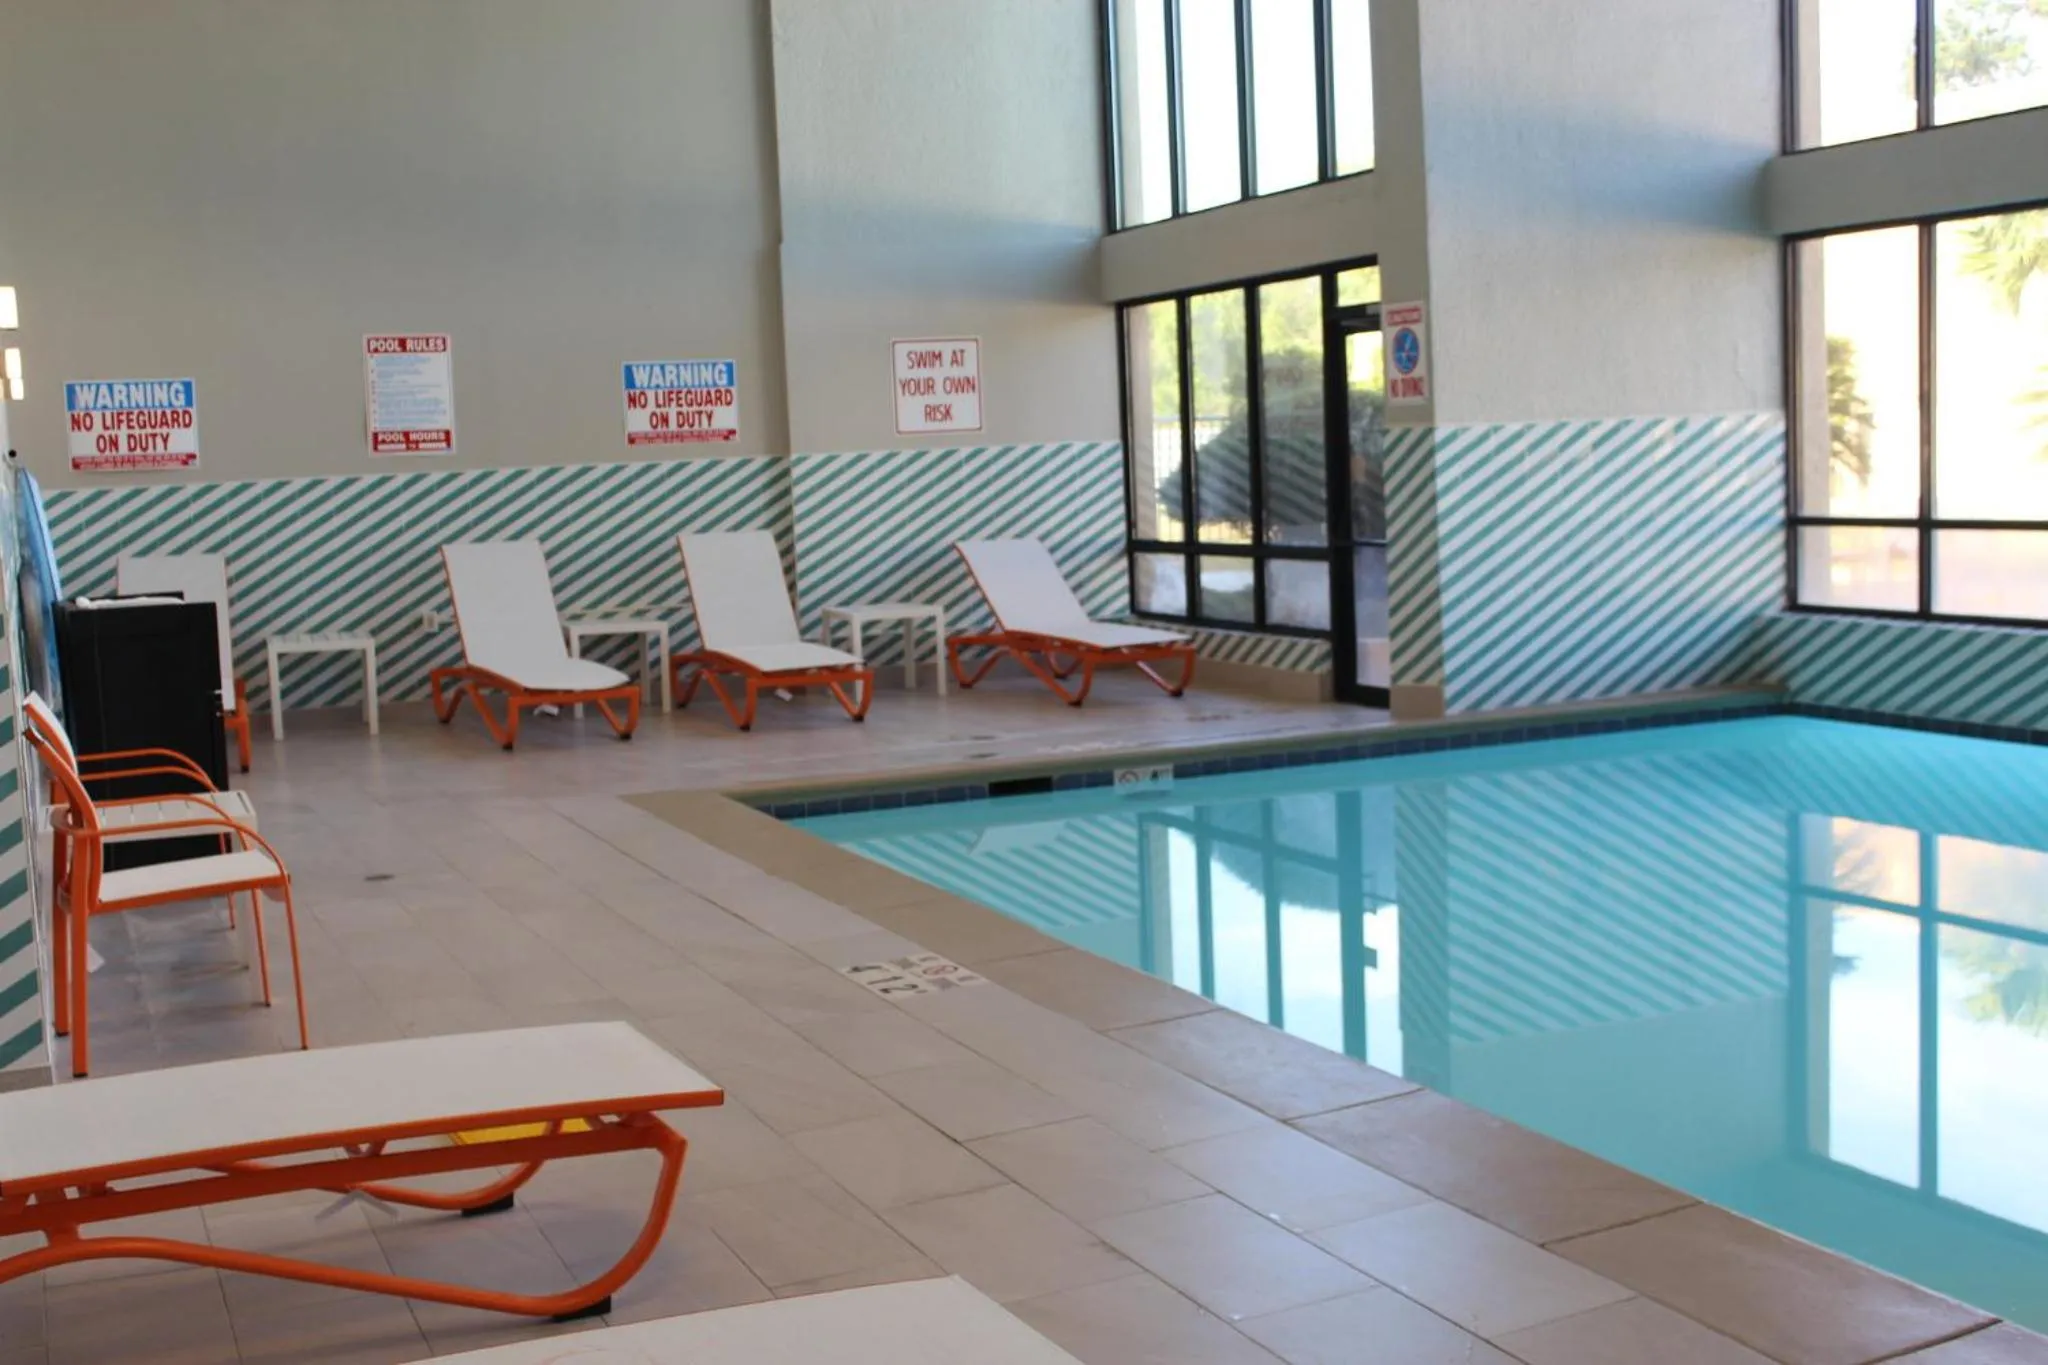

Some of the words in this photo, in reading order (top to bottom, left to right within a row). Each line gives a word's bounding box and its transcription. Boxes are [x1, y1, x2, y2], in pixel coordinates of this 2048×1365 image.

[369, 339, 402, 352] POOL
[406, 338, 445, 352] RULES
[906, 350, 943, 369] SWIM
[950, 349, 966, 368] AT
[632, 363, 728, 388] WARNING
[75, 382, 186, 410] WARNING
[899, 377, 936, 396] YOUR
[943, 376, 976, 395] OWN
[627, 391, 648, 409] NO
[655, 388, 733, 408] LIFEGUARD
[71, 412, 94, 432] NO
[101, 410, 192, 431] LIFEGUARD
[649, 411, 669, 429] ON
[676, 410, 713, 428] DUTY
[924, 403, 953, 423] RISK
[96, 434, 119, 453] ON
[127, 432, 170, 452] DUTY
